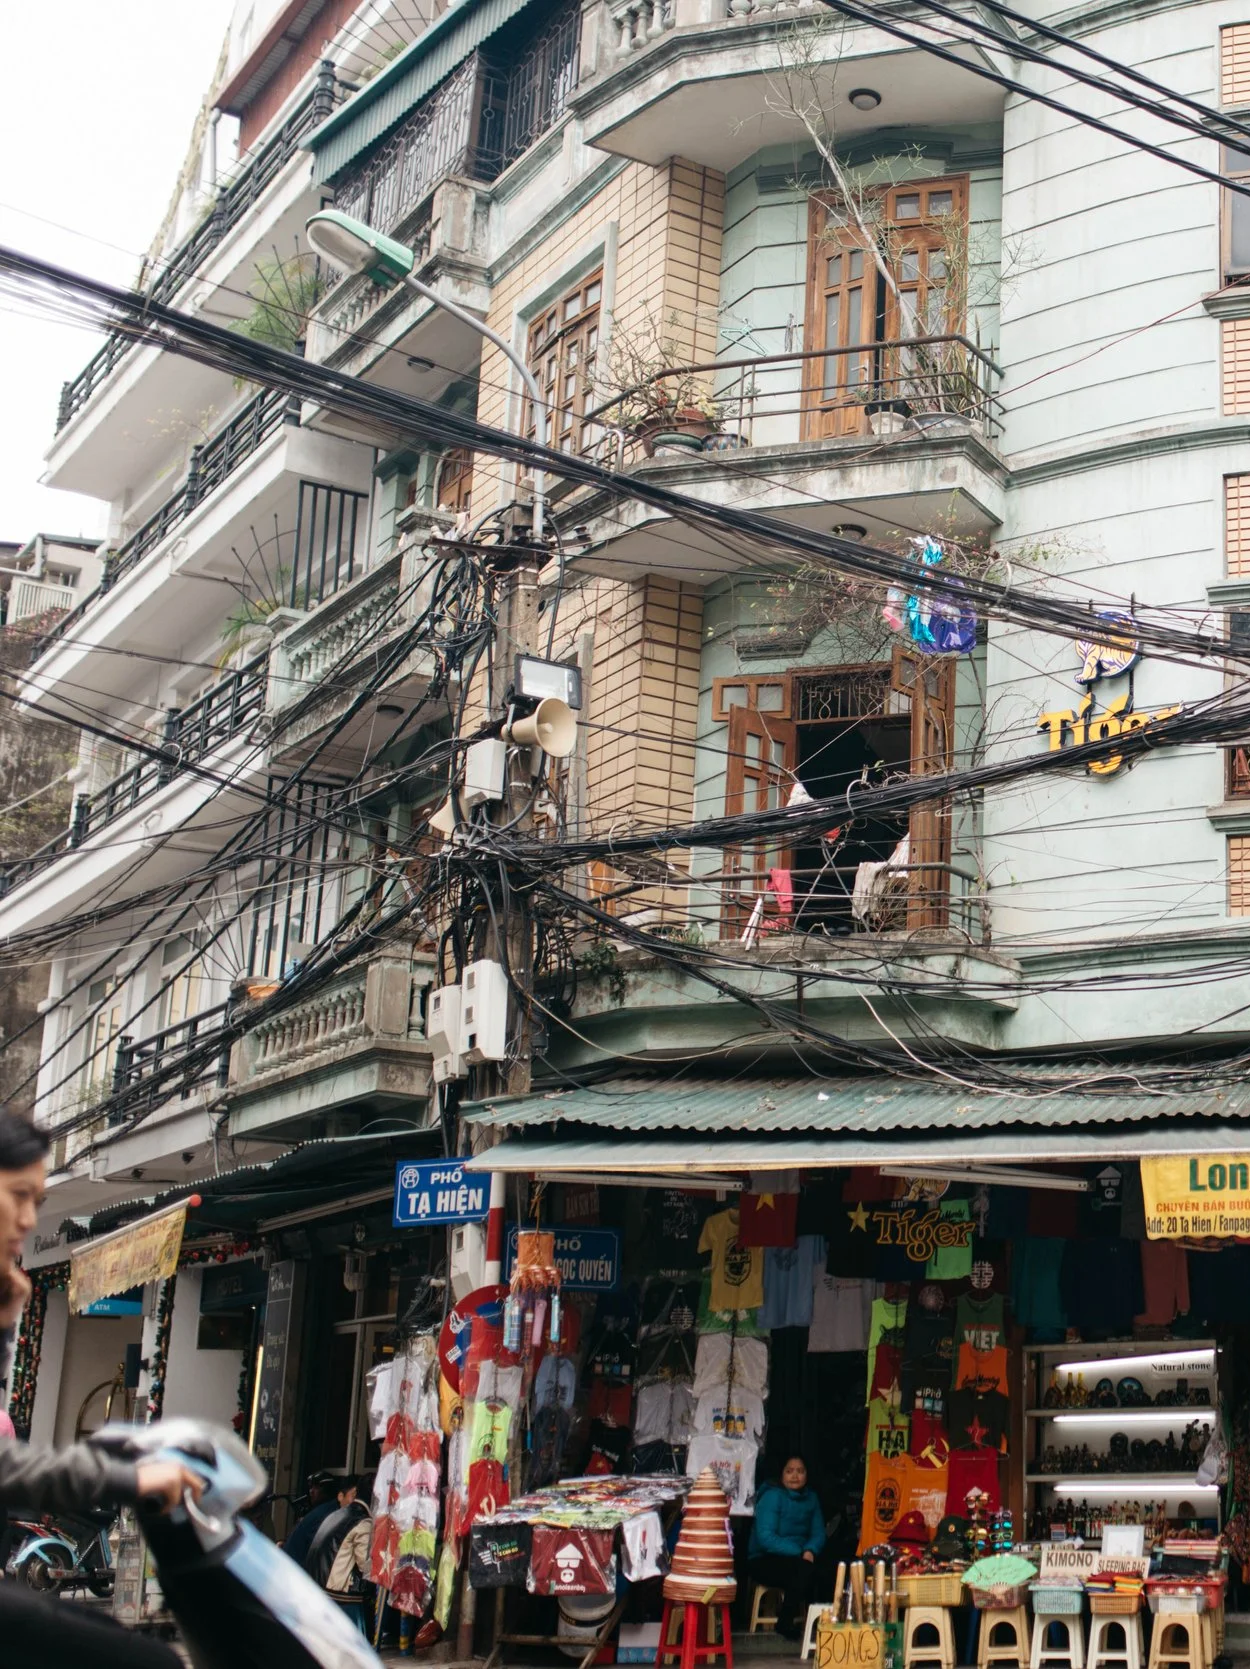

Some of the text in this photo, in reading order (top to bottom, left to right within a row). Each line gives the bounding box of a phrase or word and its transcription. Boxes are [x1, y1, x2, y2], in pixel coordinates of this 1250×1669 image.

[430, 1165, 464, 1185] PHỐ
[408, 1184, 484, 1219] TẠ HIỆN
[1167, 1216, 1177, 1233] 20
[1180, 1216, 1189, 1233] Ta
[1191, 1215, 1211, 1232] Hien
[553, 1234, 583, 1251] HỐ
[872, 1207, 978, 1262] Tiger
[554, 1253, 612, 1285] GỌC QUYẾN
[93, 1303, 110, 1311] ATM
[964, 1330, 1000, 1352] VIET
[1151, 1361, 1211, 1372] Natural stone
[1046, 1552, 1094, 1567] KIMONO
[1097, 1559, 1146, 1575] SLEEPING BAG
[818, 1627, 881, 1668] BONGS
